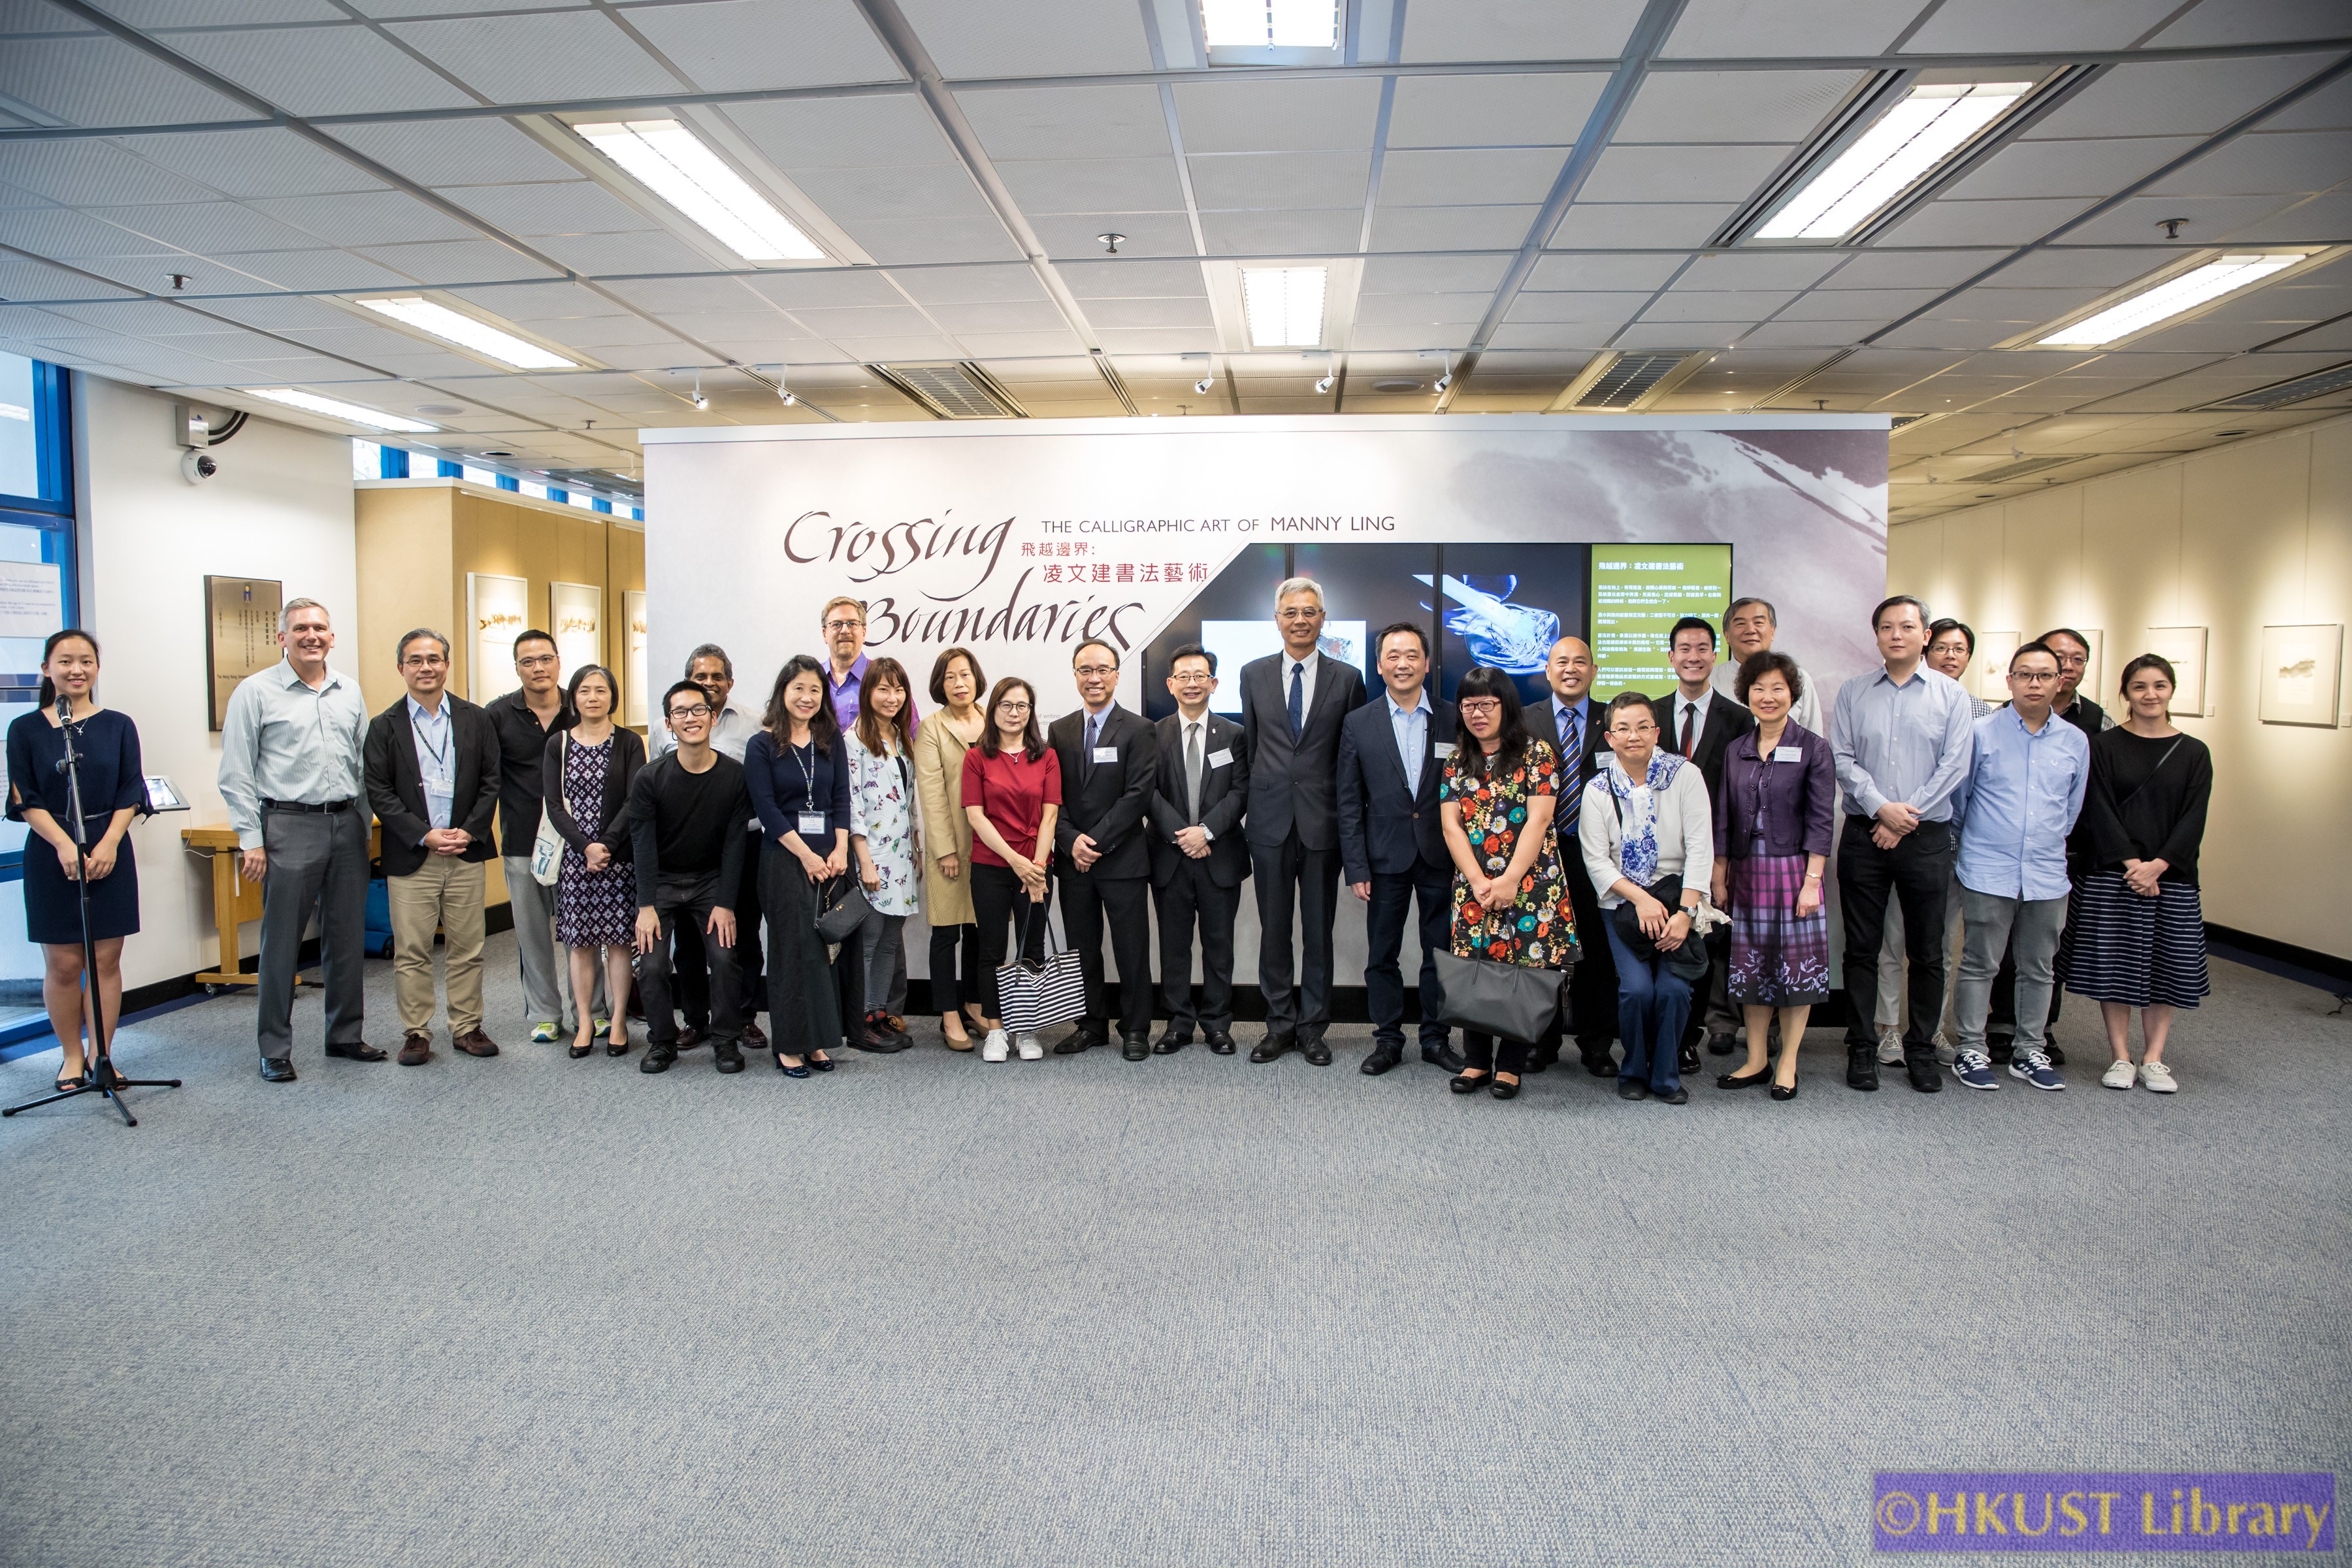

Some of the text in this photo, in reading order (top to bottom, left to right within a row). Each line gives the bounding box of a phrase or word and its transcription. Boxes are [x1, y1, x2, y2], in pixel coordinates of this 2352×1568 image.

[1041, 516, 1395, 533] THE CALLIGRAPHIC ART OF MANNY LING
[785, 510, 1017, 602] Crossing
[1021, 542, 1095, 557] 飛越邊界:
[1043, 563, 1207, 583] 凌文建書法藝術
